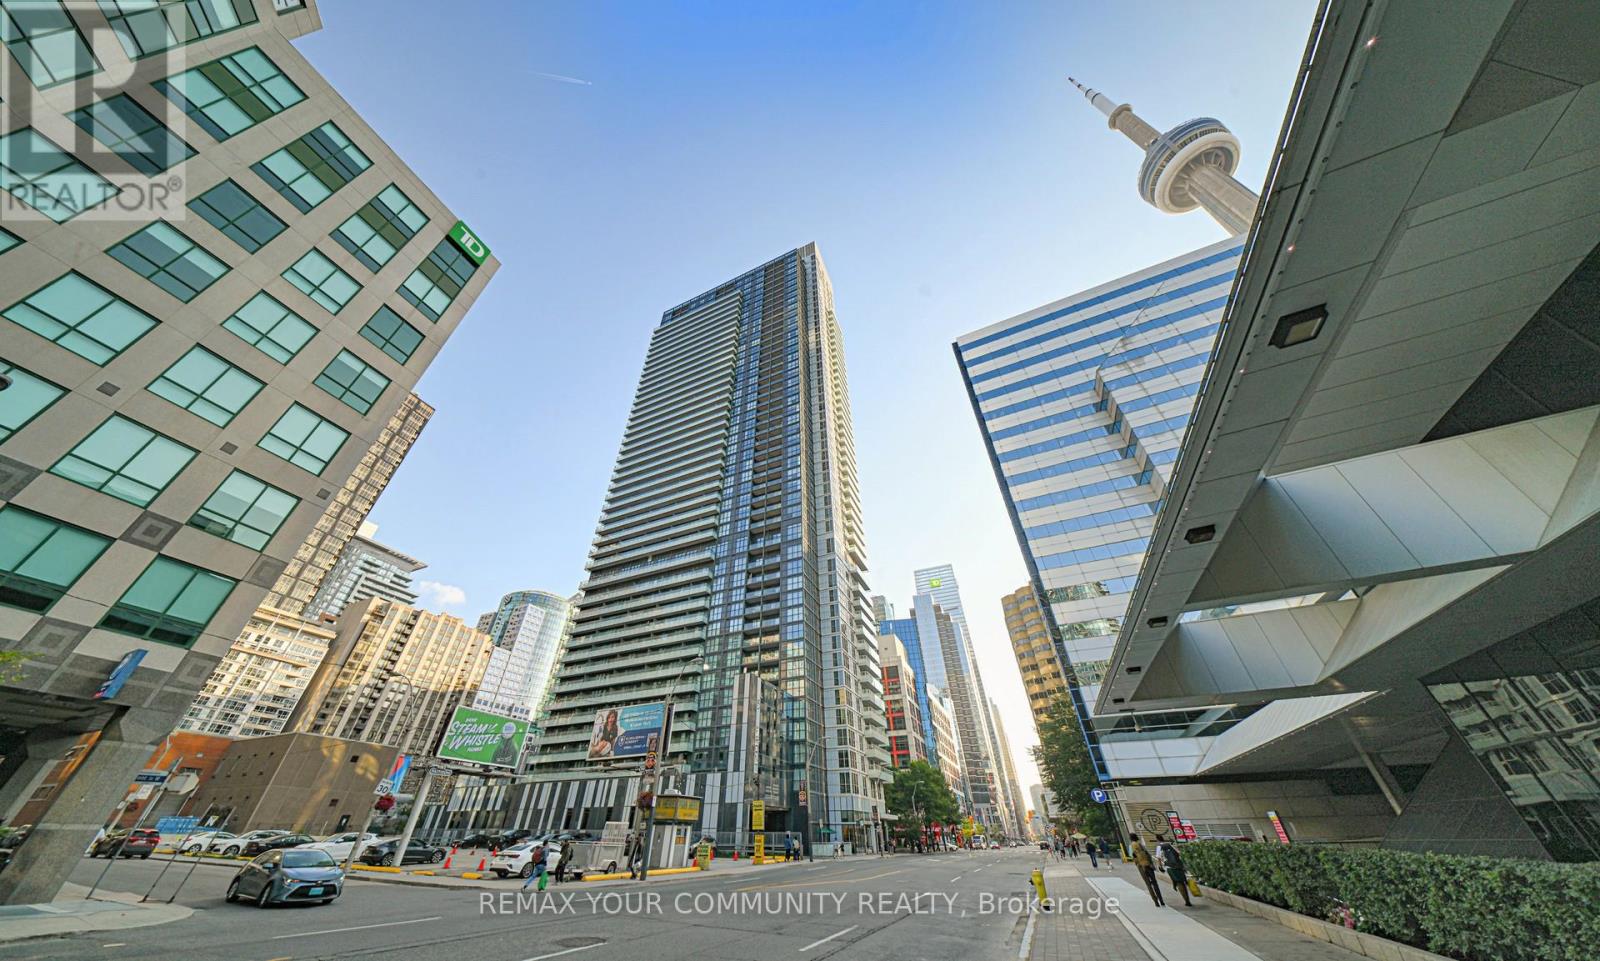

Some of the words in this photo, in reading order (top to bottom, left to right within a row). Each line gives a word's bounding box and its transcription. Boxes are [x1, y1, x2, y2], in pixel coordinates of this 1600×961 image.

[460, 226, 484, 257] TD
[448, 721, 488, 735] STEAM
[449, 733, 501, 750] WHISTLE
[376, 784, 389, 794] 30
[1093, 790, 1103, 801] P
